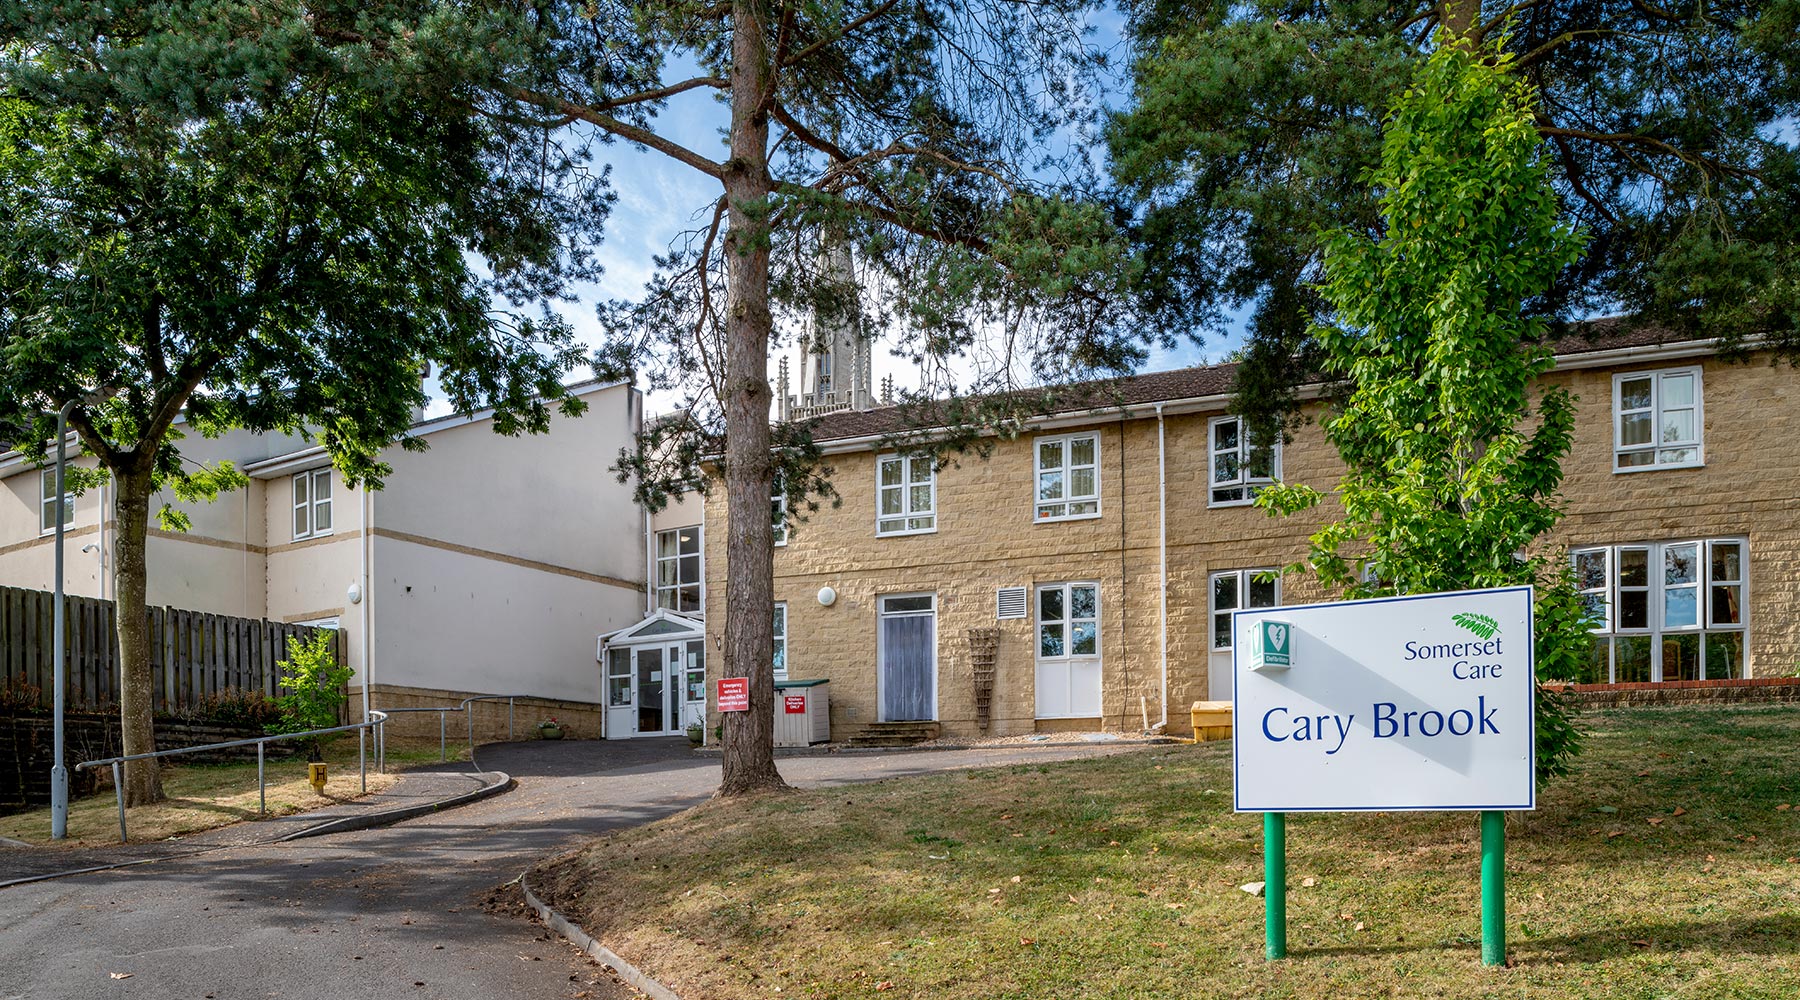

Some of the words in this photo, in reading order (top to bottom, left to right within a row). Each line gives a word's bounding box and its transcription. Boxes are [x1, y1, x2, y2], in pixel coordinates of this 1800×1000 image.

[1404, 637, 1503, 661] Somerset
[1452, 660, 1502, 680] Care
[1261, 707, 1355, 755] Cary
[1372, 695, 1500, 739] Brook
[316, 767, 325, 780] H
